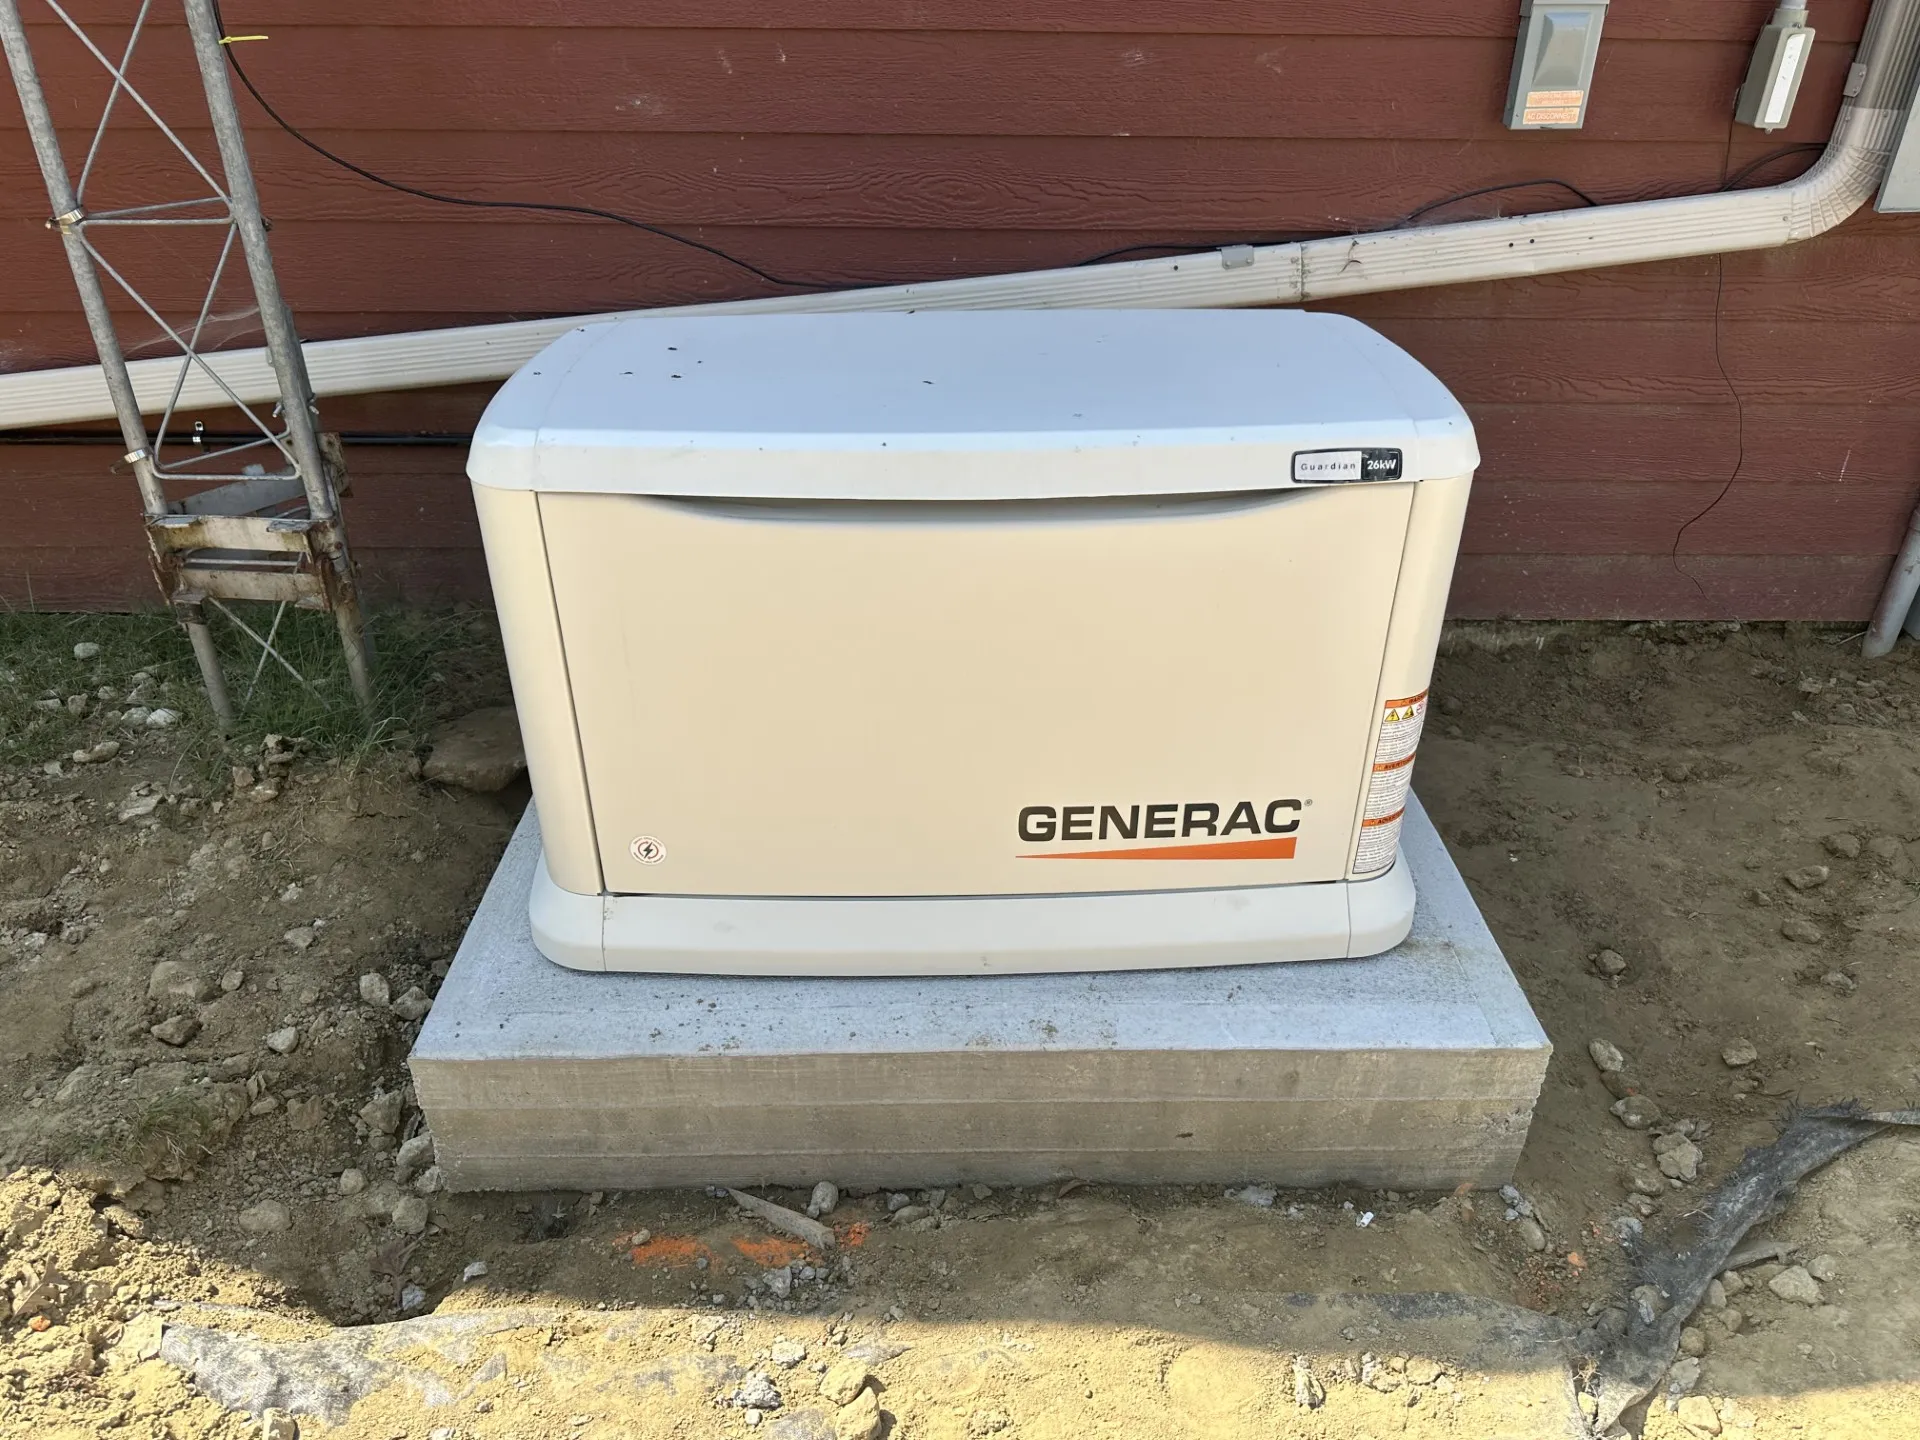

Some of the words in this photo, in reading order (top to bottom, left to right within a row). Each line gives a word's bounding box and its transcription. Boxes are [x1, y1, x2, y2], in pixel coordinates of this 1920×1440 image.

[1536, 112, 1575, 120] DISCONNECT
[1300, 462, 1356, 471] Guardian
[1367, 459, 1397, 470] 26kW
[1018, 799, 1302, 842] GENERAC
